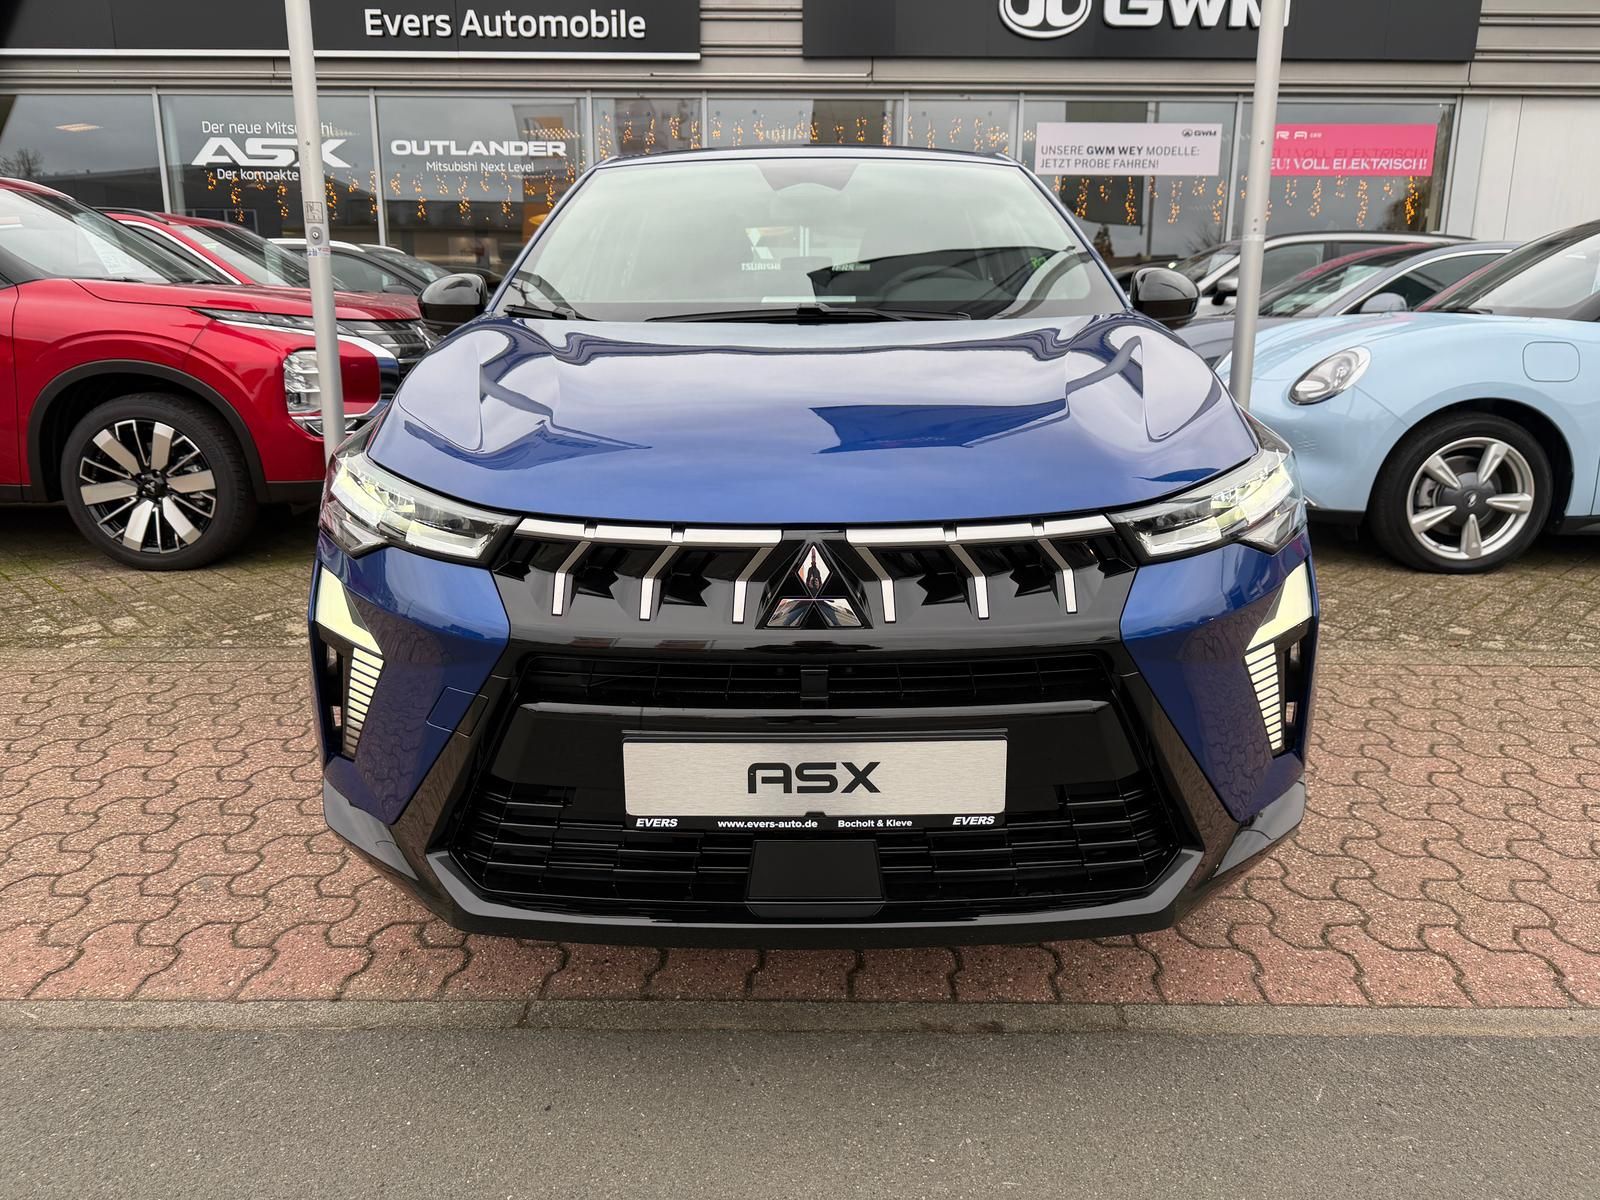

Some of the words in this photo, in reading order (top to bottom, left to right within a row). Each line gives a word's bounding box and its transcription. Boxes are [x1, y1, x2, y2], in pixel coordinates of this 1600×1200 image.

[363, 8, 451, 37] Evers
[460, 9, 646, 38] Automobile
[201, 121, 223, 134] Der
[229, 123, 262, 134] neue
[266, 121, 334, 137] Mitshi
[1276, 130, 1308, 140] RA
[191, 137, 352, 168] ASX
[390, 139, 568, 157] OUTLANDER
[1040, 145, 1084, 156] UNSERE
[1086, 145, 1115, 156] GWM
[1118, 146, 1144, 156] WEY
[1146, 146, 1200, 157] MODELLE:
[426, 161, 478, 172] Mitsubishi
[480, 162, 505, 172] Next
[508, 162, 535, 173] Level
[1040, 158, 1072, 169] JETZT
[1074, 158, 1110, 169] PROBE
[1113, 158, 1159, 169] FAHREN!
[1270, 158, 1291, 170] EU!
[1294, 158, 1330, 170] VOLL
[1332, 157, 1428, 170] ELEKTRISCH!
[216, 168, 237, 180] Der
[240, 169, 299, 183] kompakte
[748, 762, 881, 794] ASX
[636, 818, 679, 828] EVERS
[717, 819, 818, 828] www.evers-auto.de
[837, 819, 875, 828] Bocholt
[876, 819, 884, 828] &
[886, 819, 913, 827] Kleve
[952, 815, 995, 826] EVERS
